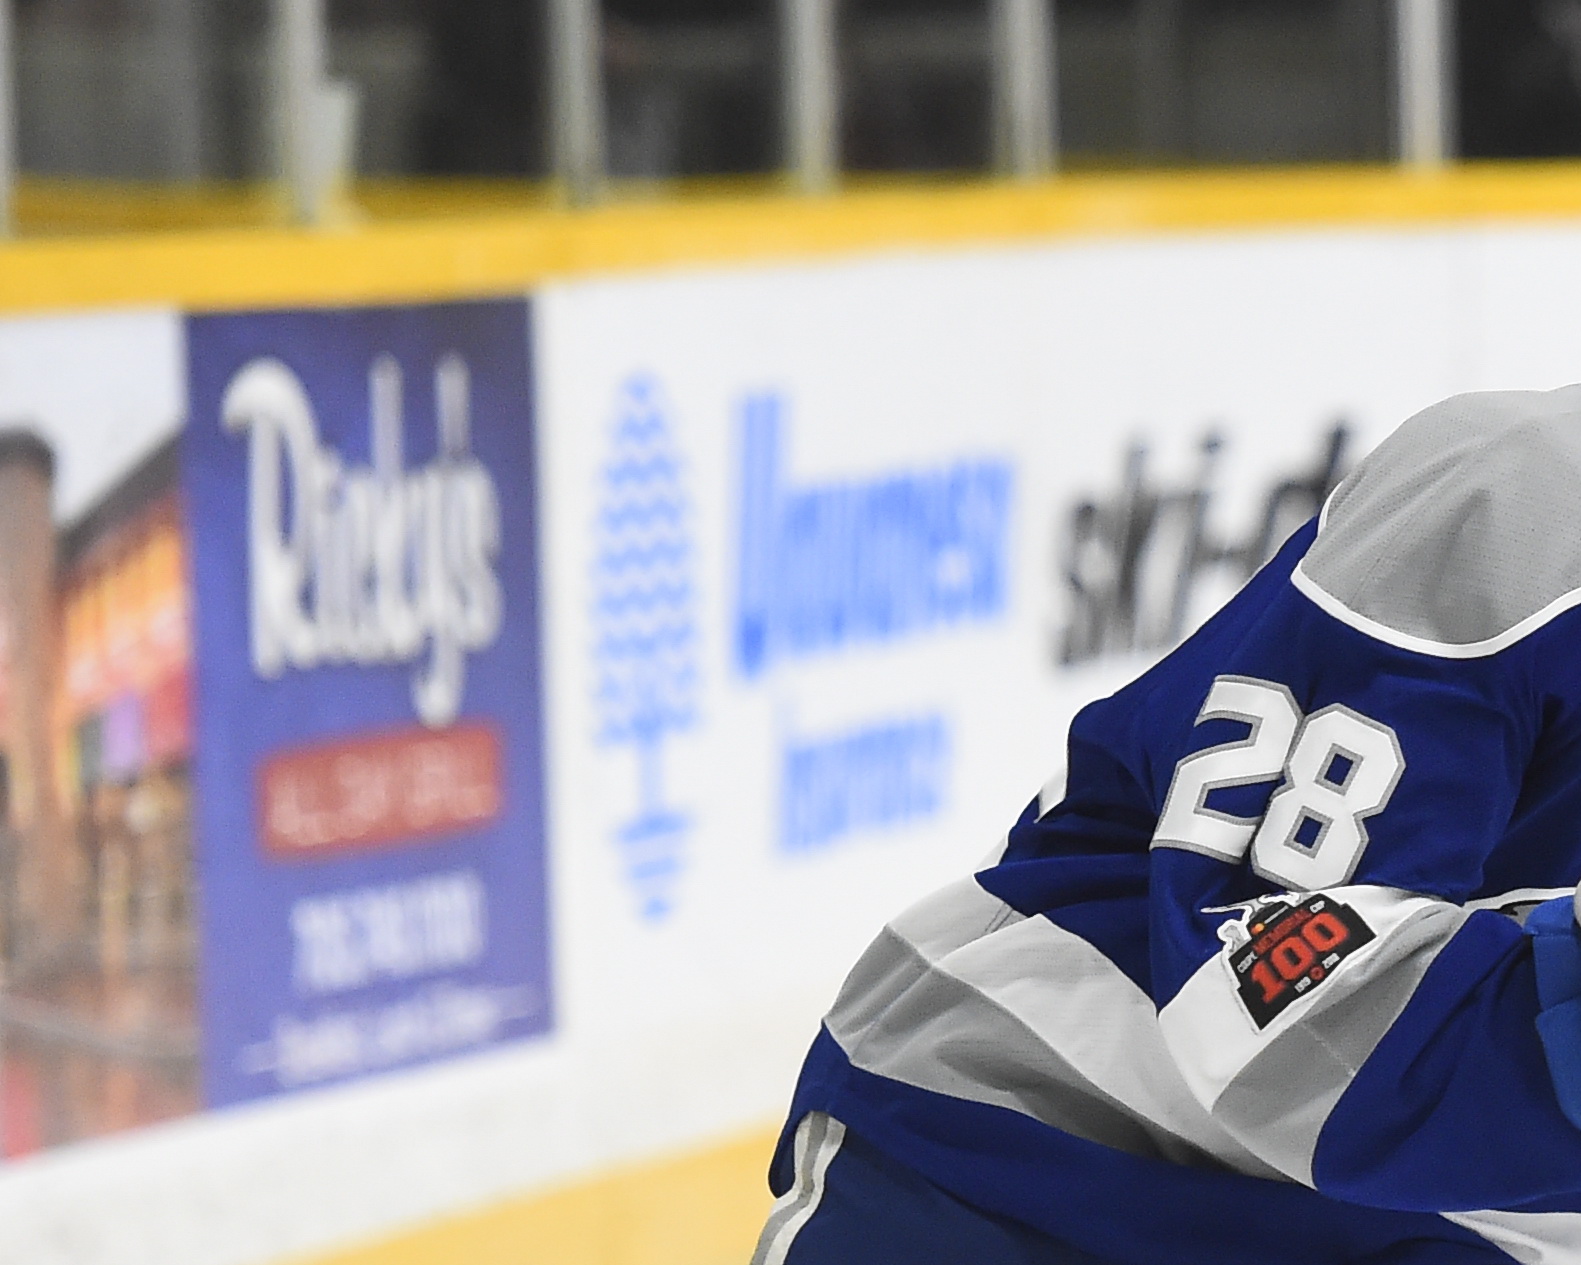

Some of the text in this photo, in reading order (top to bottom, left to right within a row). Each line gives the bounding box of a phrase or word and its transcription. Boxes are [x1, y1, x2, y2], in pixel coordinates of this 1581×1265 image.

[222, 358, 505, 728] Ricky's
[1149, 674, 1407, 892] 28
[1252, 912, 1349, 1004] 100
